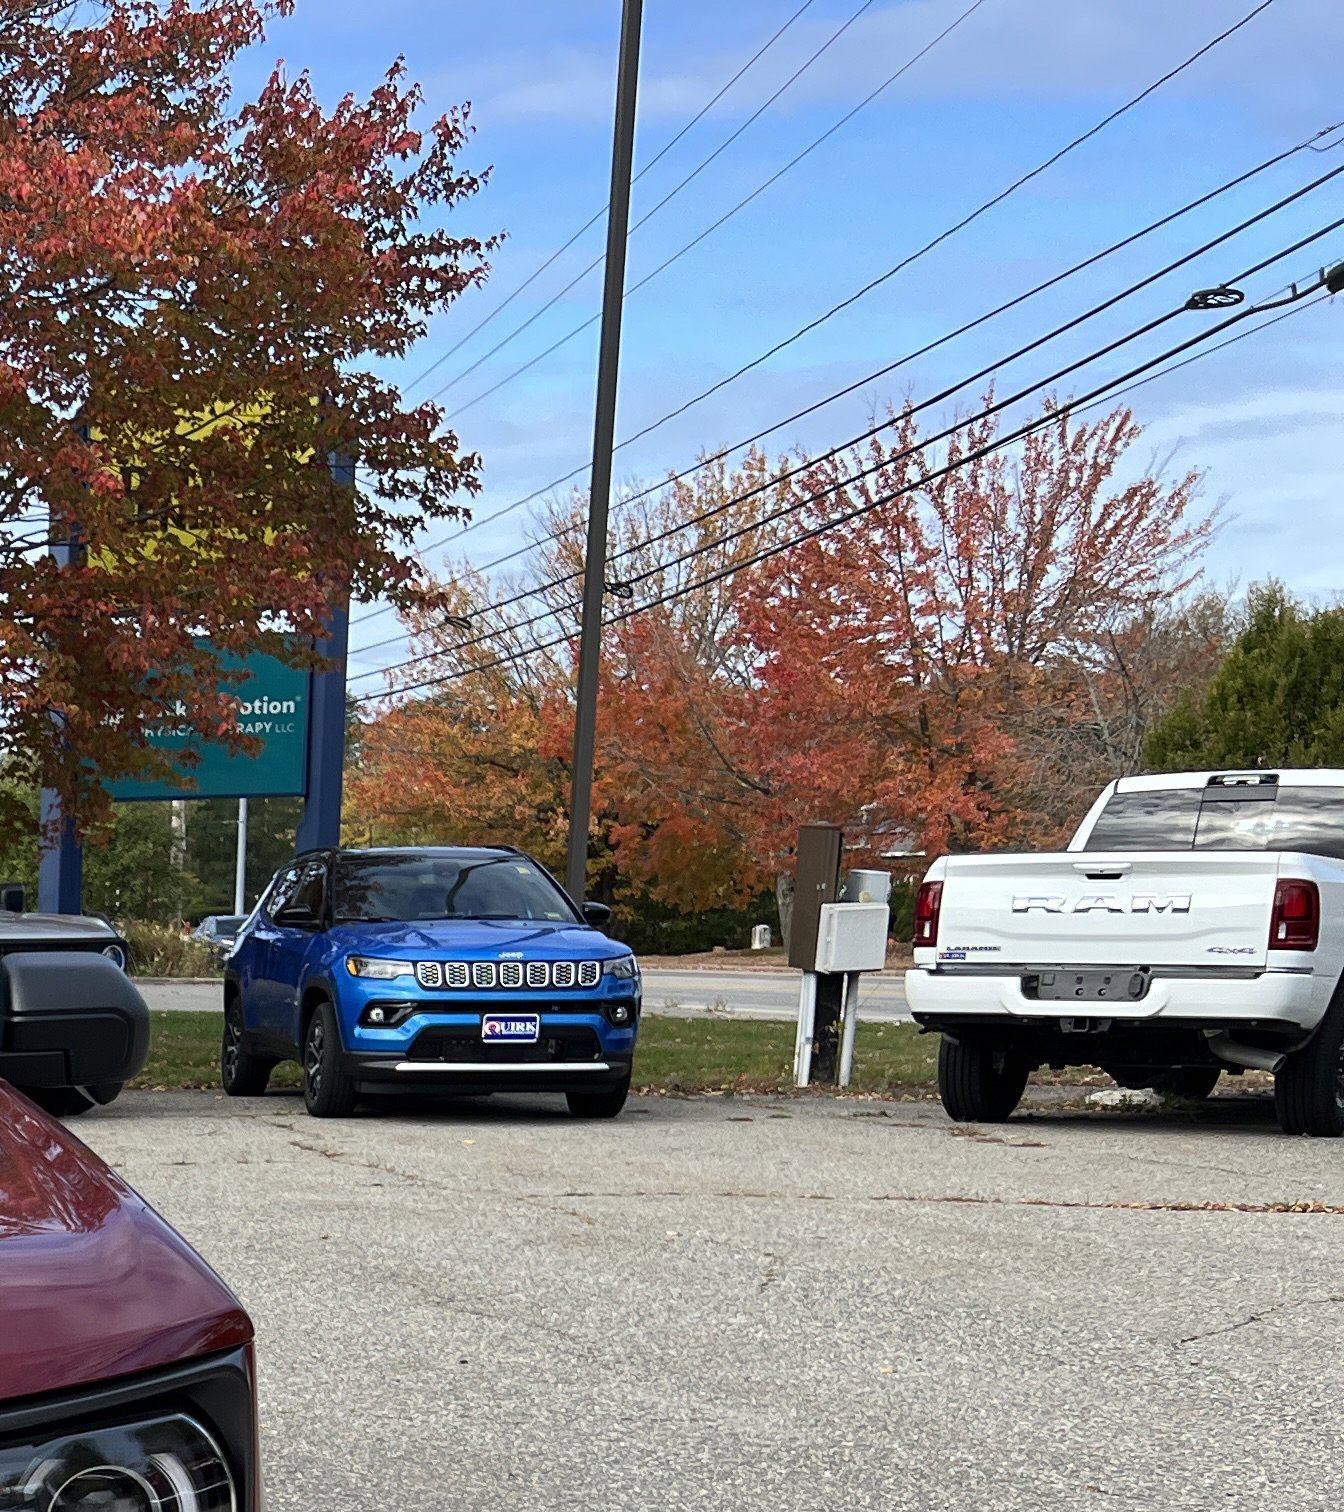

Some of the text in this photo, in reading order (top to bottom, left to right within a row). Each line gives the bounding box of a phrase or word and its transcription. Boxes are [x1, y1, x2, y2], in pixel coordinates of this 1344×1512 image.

[275, 723, 295, 733] LLC
[1012, 892, 1193, 914] RAM
[484, 1021, 536, 1035] QUIRK
